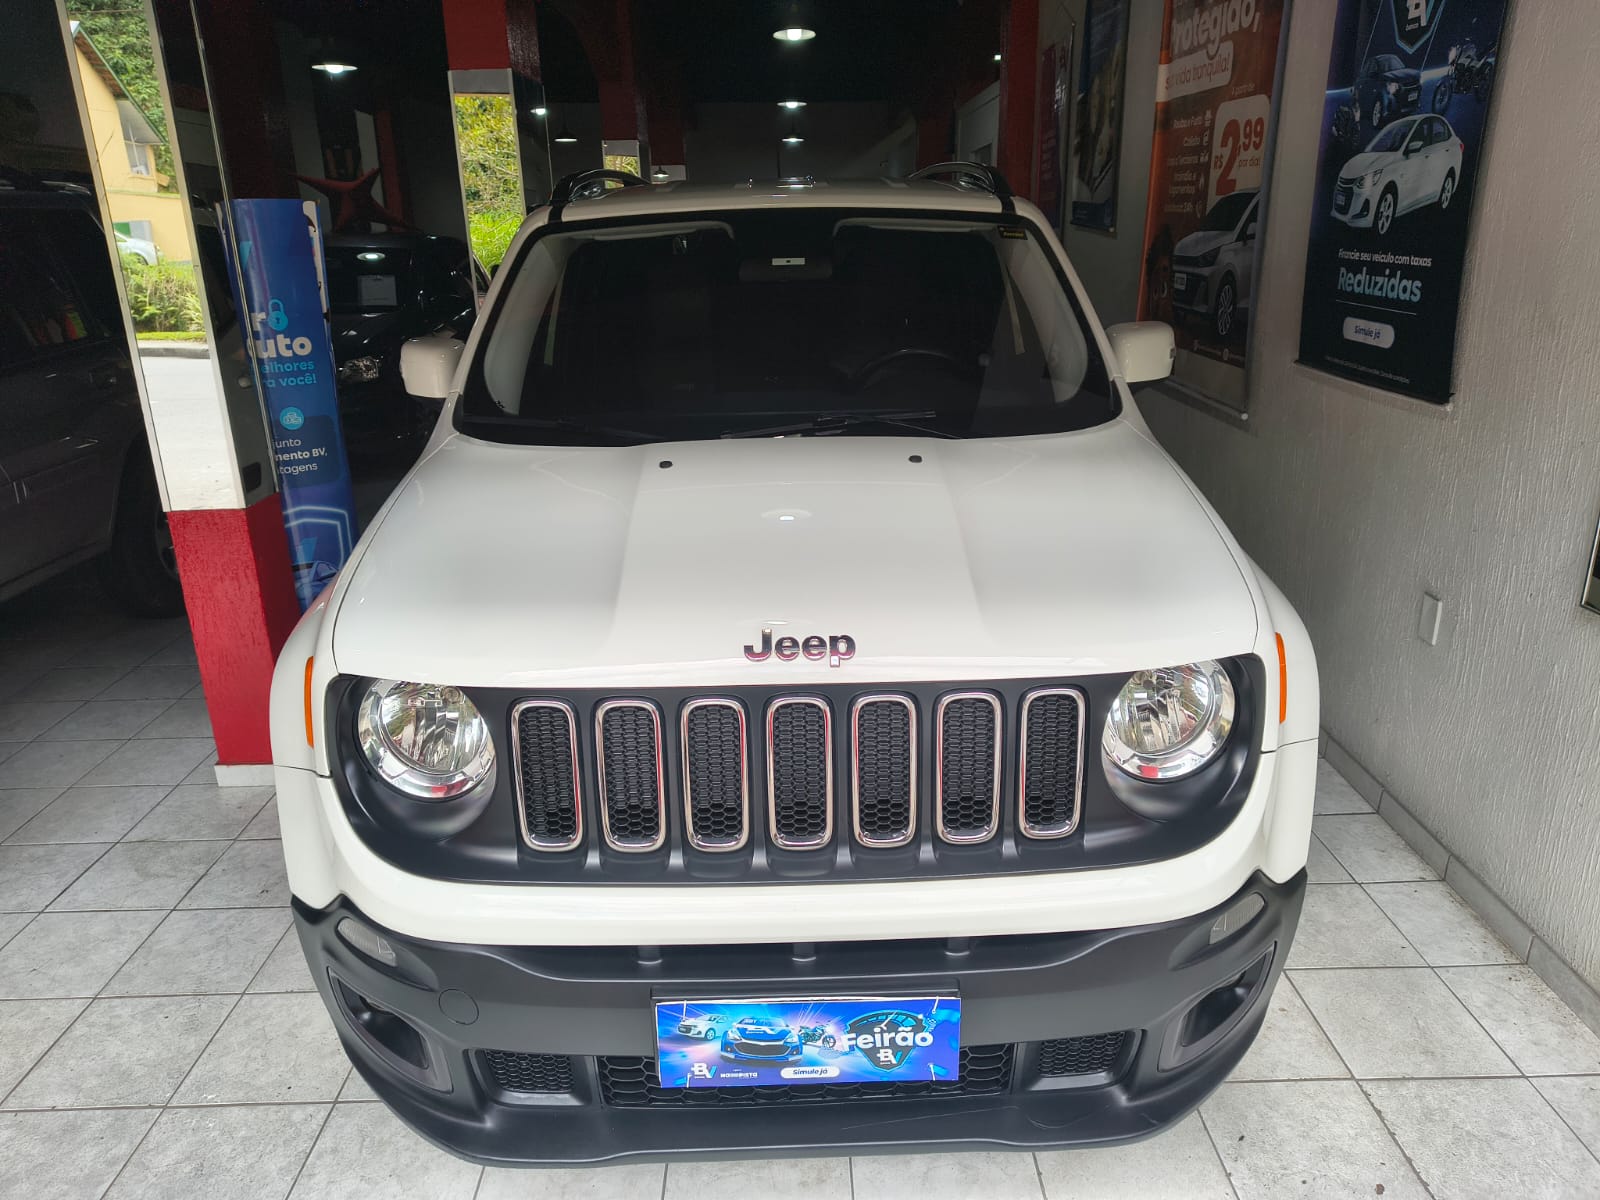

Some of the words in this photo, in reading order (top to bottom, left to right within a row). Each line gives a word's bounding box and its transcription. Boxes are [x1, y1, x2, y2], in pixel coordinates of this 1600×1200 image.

[1172, 0, 1261, 56] rotegido,
[1394, 256, 1410, 265] com
[1410, 255, 1433, 267] taxas
[1337, 266, 1423, 303] Reduzidas
[255, 334, 313, 359] uto
[261, 360, 316, 374] elhores
[279, 373, 317, 387] você!
[279, 463, 318, 476] tagens
[743, 628, 856, 668] Jeep
[841, 1026, 935, 1052] Feirão
[792, 1068, 818, 1077] Simule
